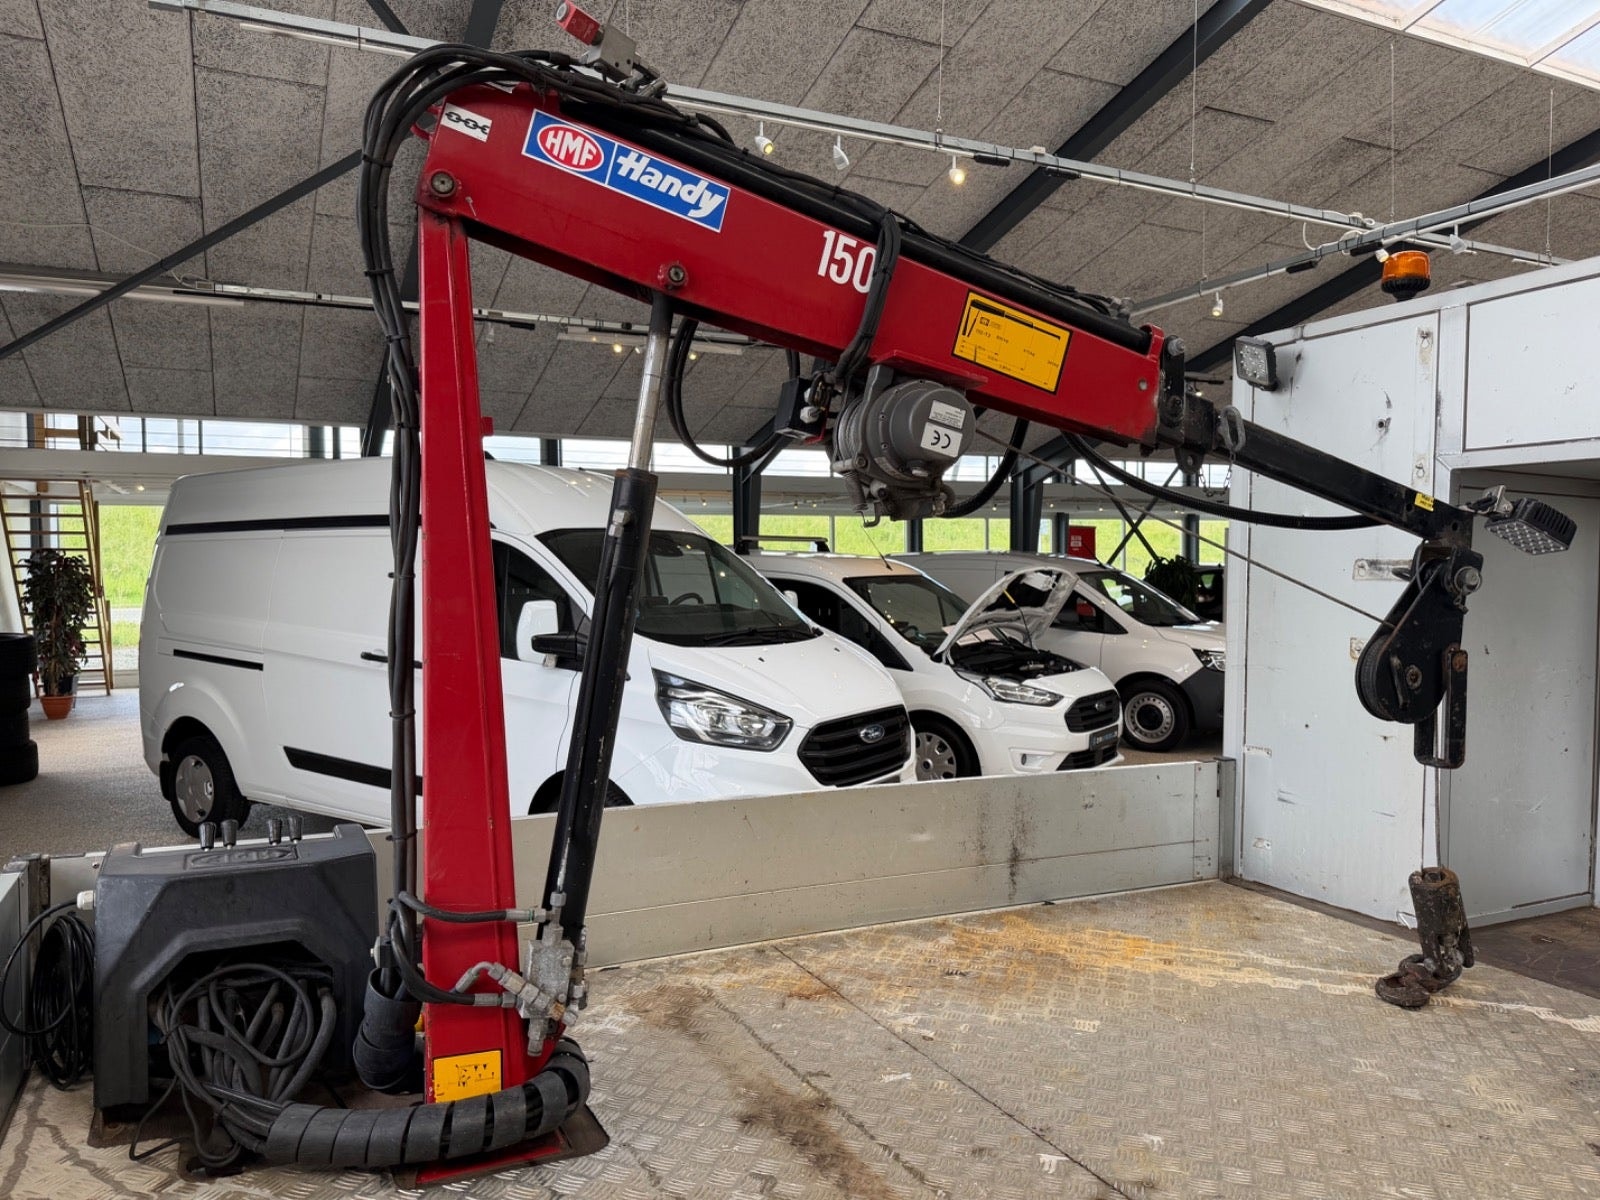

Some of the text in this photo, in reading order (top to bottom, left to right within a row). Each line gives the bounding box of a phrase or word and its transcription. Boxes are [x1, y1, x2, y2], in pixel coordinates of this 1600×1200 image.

[545, 130, 725, 218] HMF Handy
[818, 230, 877, 294] 150
[930, 430, 951, 449] CE
